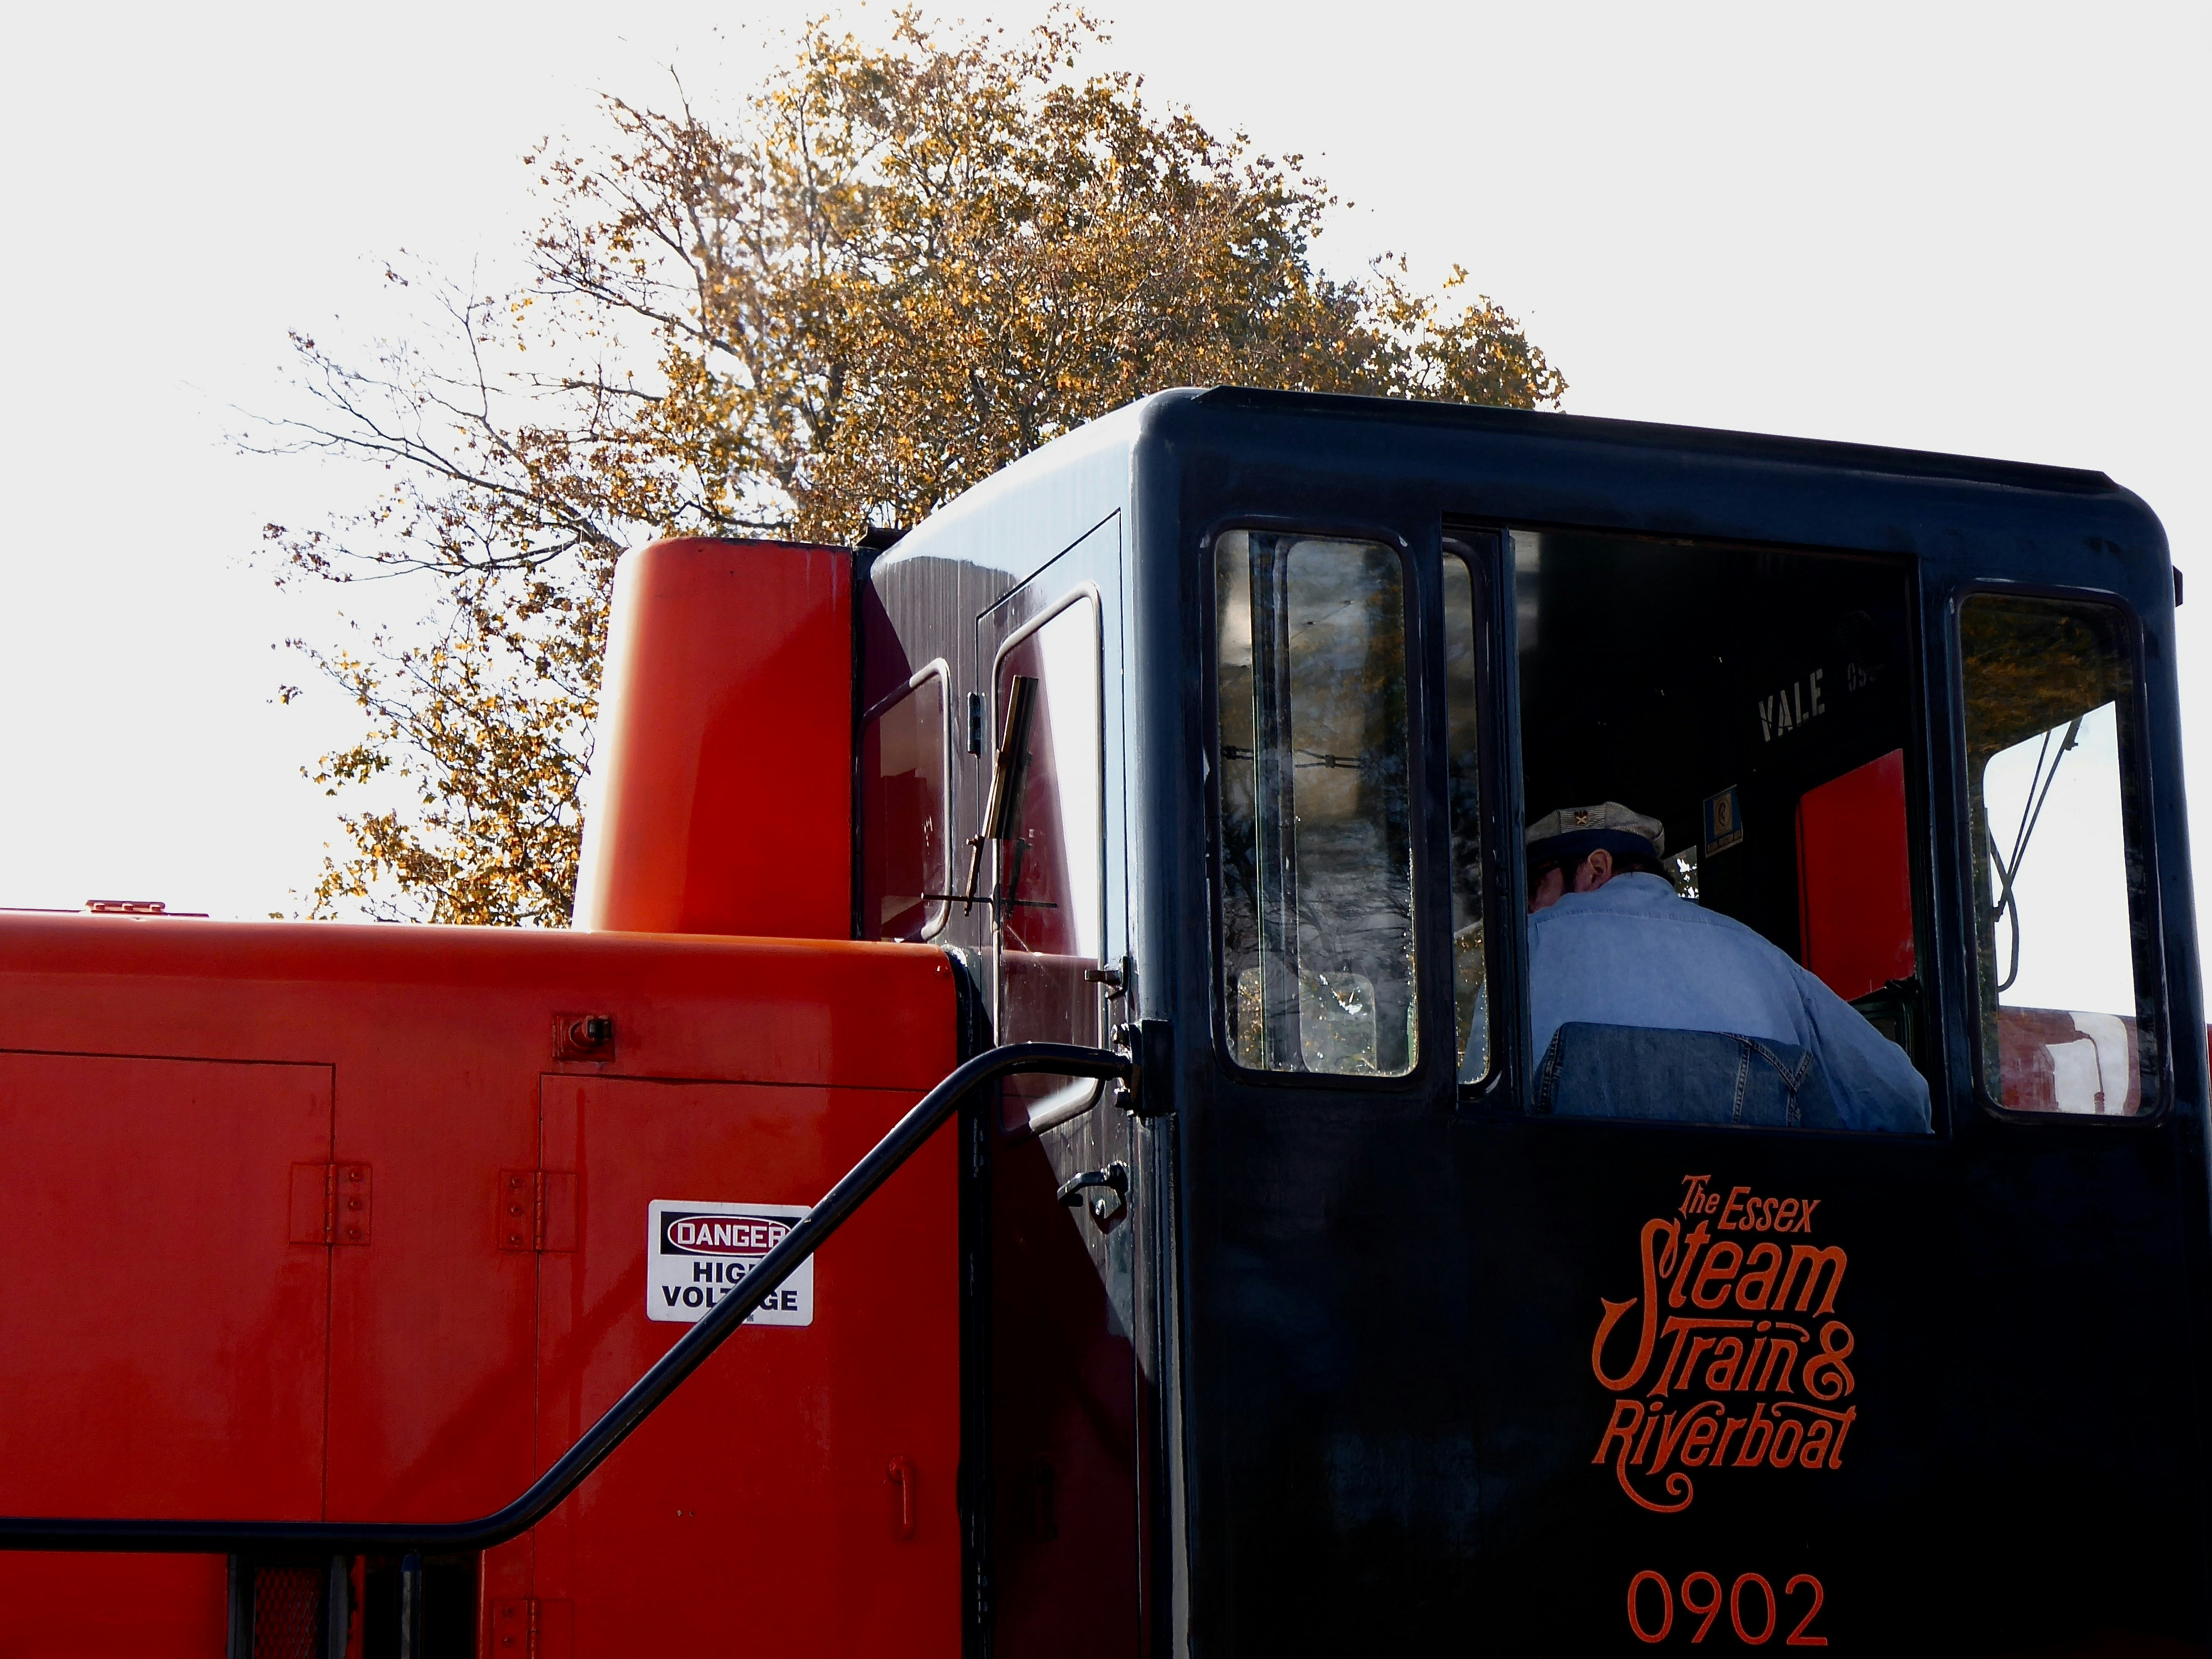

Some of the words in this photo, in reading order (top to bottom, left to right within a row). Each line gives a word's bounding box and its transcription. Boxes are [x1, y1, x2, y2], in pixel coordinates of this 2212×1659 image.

[677, 1223, 786, 1248] DANGER
[1678, 1175, 1720, 1219] The
[1718, 1187, 1821, 1232] Essex
[662, 1285, 798, 1311] VOLGE
[693, 1261, 757, 1285] HIG
[1592, 1218, 1847, 1391] Steam
[1647, 1316, 1809, 1397] Train
[1592, 1400, 1856, 1512] Riverboat
[1627, 1571, 1828, 1646] 0902
